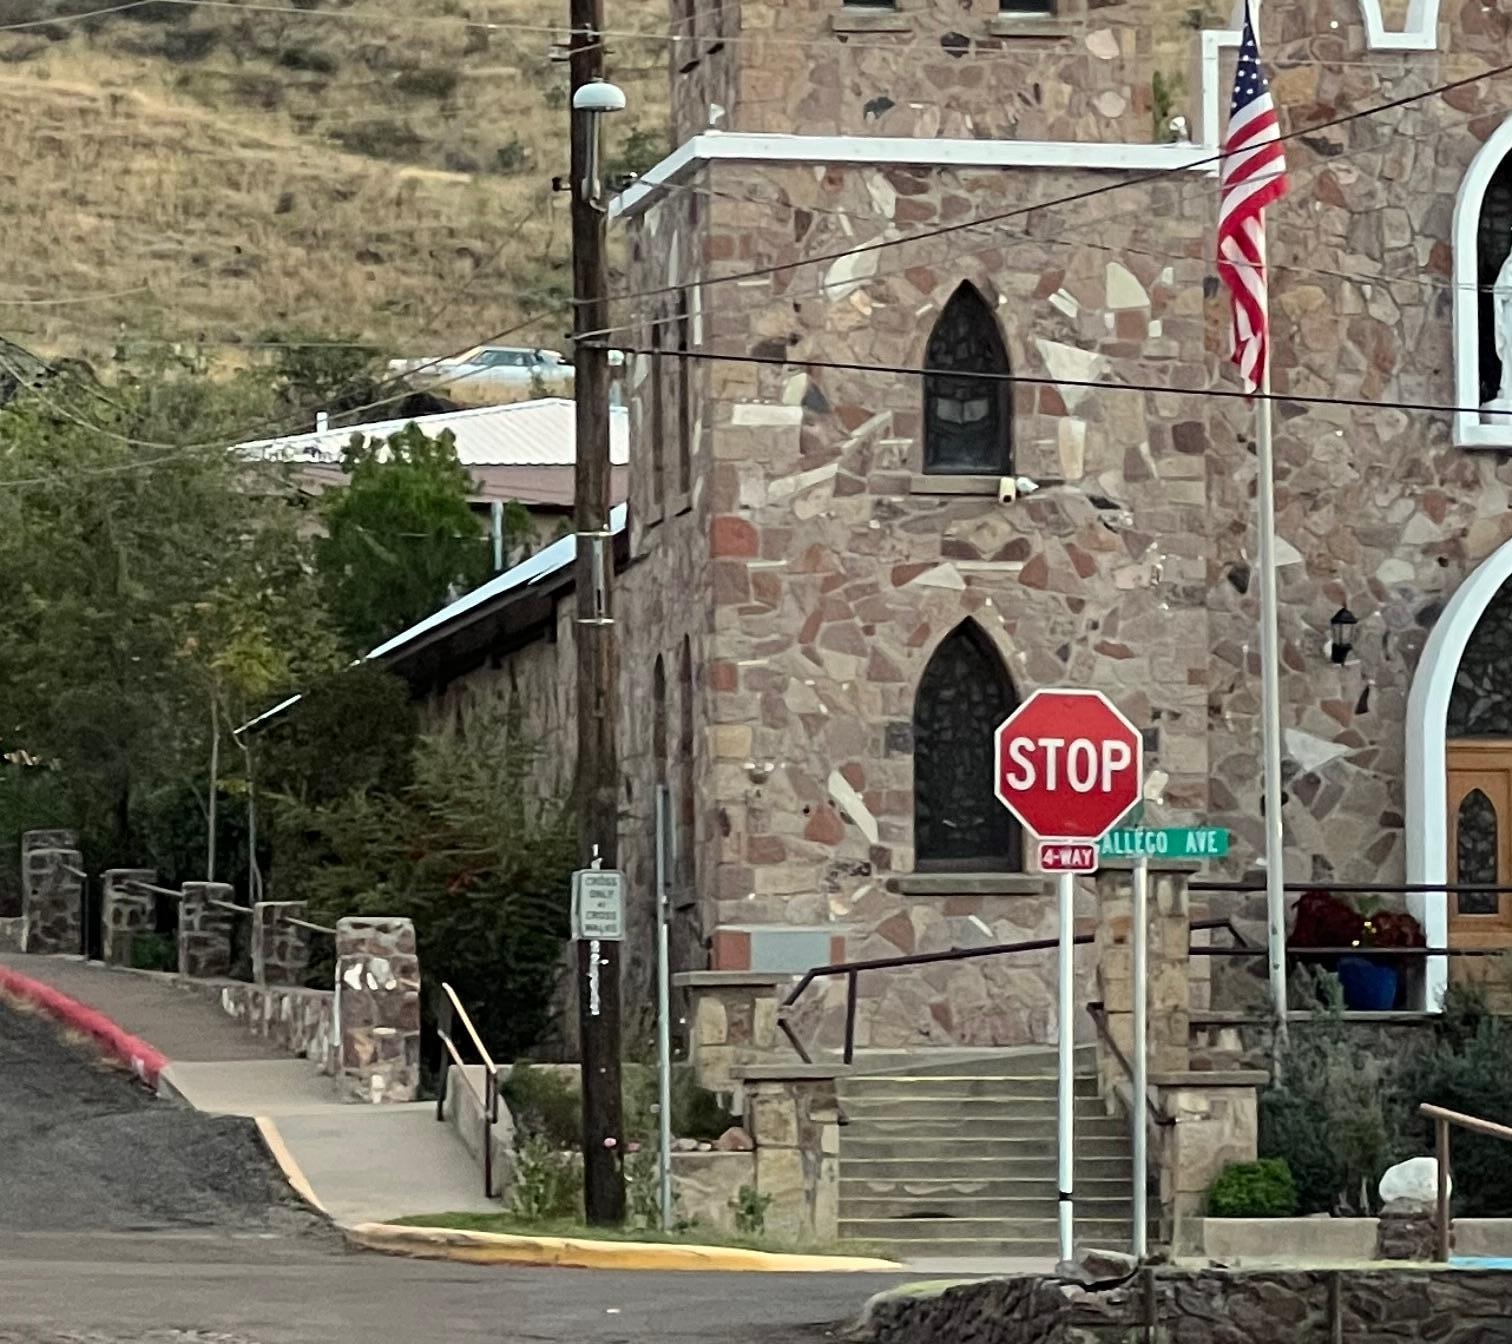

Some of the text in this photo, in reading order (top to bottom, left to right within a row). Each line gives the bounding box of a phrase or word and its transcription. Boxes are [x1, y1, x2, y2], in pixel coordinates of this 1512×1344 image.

[1006, 737, 1132, 793] STOP
[1101, 830, 1218, 854] ALLEGO AVE
[1041, 848, 1093, 867] 4-WAY
